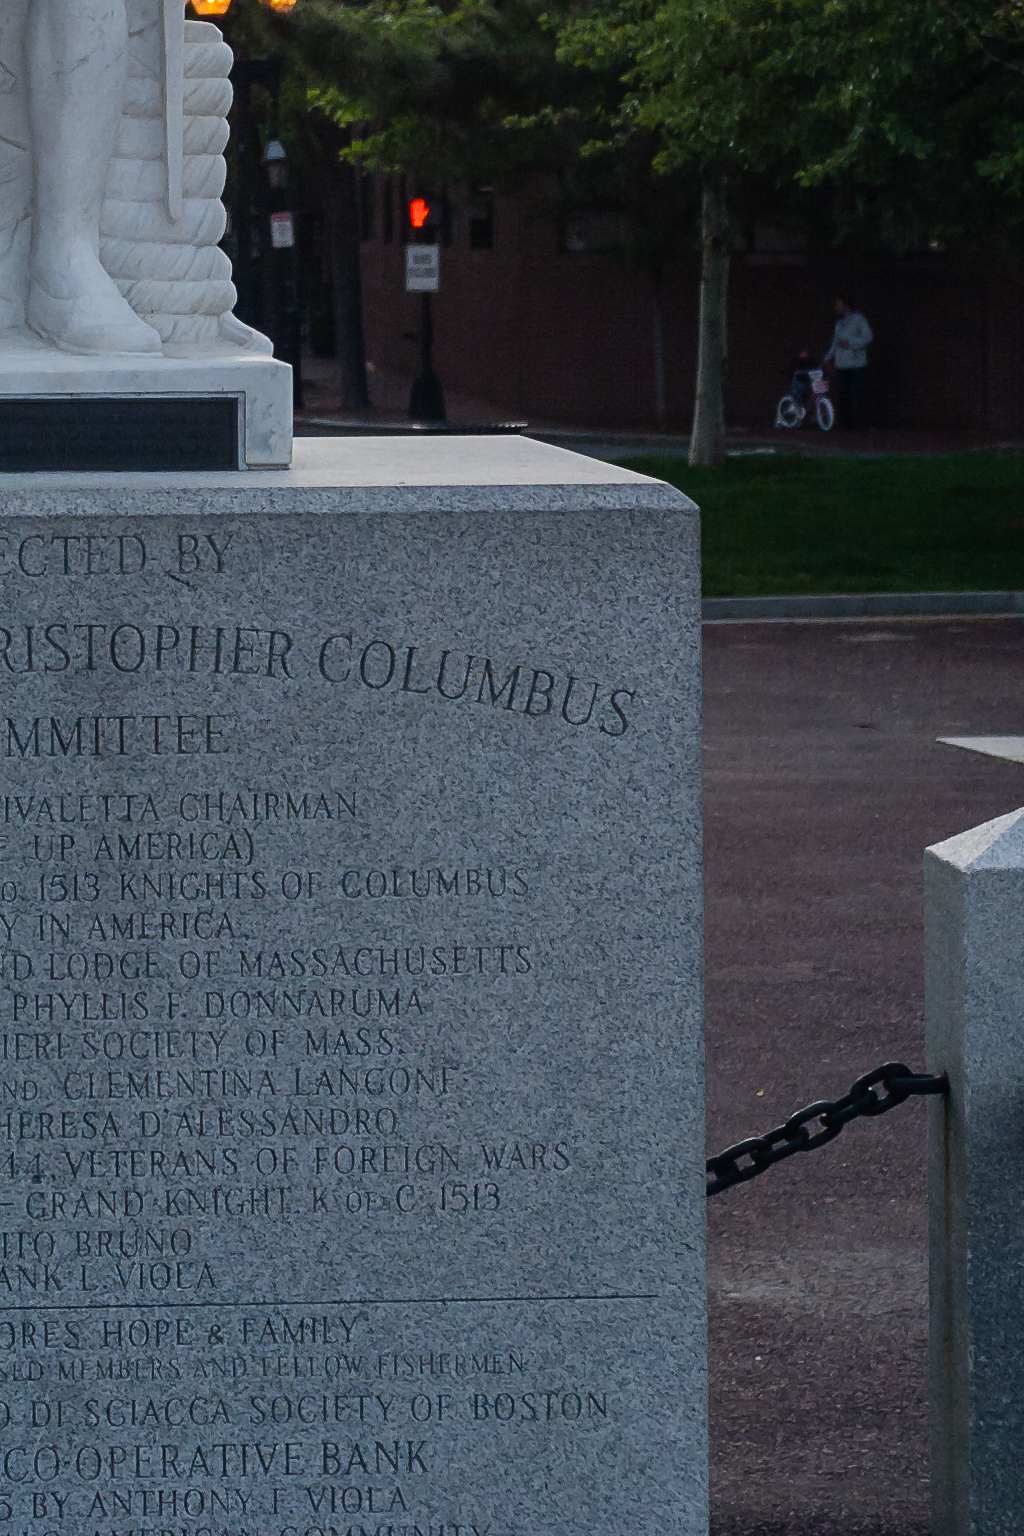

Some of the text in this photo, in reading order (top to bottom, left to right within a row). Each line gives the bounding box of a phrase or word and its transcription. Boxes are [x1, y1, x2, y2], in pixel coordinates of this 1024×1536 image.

[178, 535, 234, 574] BY
[319, 633, 638, 737] COLUMBUS
[179, 791, 359, 823] CHAIRMAN
[34, 835, 76, 863] UP
[93, 828, 255, 866] AMERICA)
[40, 873, 100, 903] 1513
[120, 871, 267, 902] KNIGHTS
[281, 871, 319, 900] OF
[342, 868, 530, 899] COLUMBUS
[39, 913, 71, 942] IN
[48, 952, 159, 982] LODGE
[179, 950, 217, 980] OF
[239, 946, 532, 978] MASSACHUSETTS
[13, 992, 149, 1022] PHYLLIS
[204, 990, 425, 1019] DONNARUMA
[82, 1031, 227, 1060] SOCIETY
[245, 1030, 283, 1058] OF
[63, 1069, 276, 1101] CLEMENTINA
[295, 1066, 458, 1096] LANGONE
[140, 1107, 398, 1139] D'ALESSANDRO
[64, 1148, 238, 1180] VETERANS
[256, 1147, 298, 1177] OF
[314, 1145, 462, 1177] FOREIGN
[480, 1142, 571, 1172] WARS
[26, 1191, 144, 1221] GRAND
[345, 1191, 377, 1215] OF
[440, 1182, 502, 1212] 1513
[76, 1228, 193, 1259] BRUNO
[114, 1262, 219, 1291] VIOLA
[101, 1318, 193, 1349] HOPE
[207, 1323, 225, 1345] &
[241, 1315, 360, 1346] FAMILY
[56, 1357, 182, 1382] MEMBERS
[193, 1355, 246, 1379] AND
[261, 1354, 364, 1378] FELLOW
[378, 1352, 525, 1376] FISHERMEN
[30, 1400, 65, 1429] DI
[84, 1396, 231, 1429] SCIACCA
[248, 1392, 396, 1426] SOCIETY
[411, 1392, 454, 1422] OF
[474, 1390, 610, 1421] BOSTON
[322, 1439, 432, 1476] BANK
[31, 1490, 71, 1519] BY
[88, 1488, 255, 1518] ANTHONY
[306, 1485, 410, 1515] VIOLA
